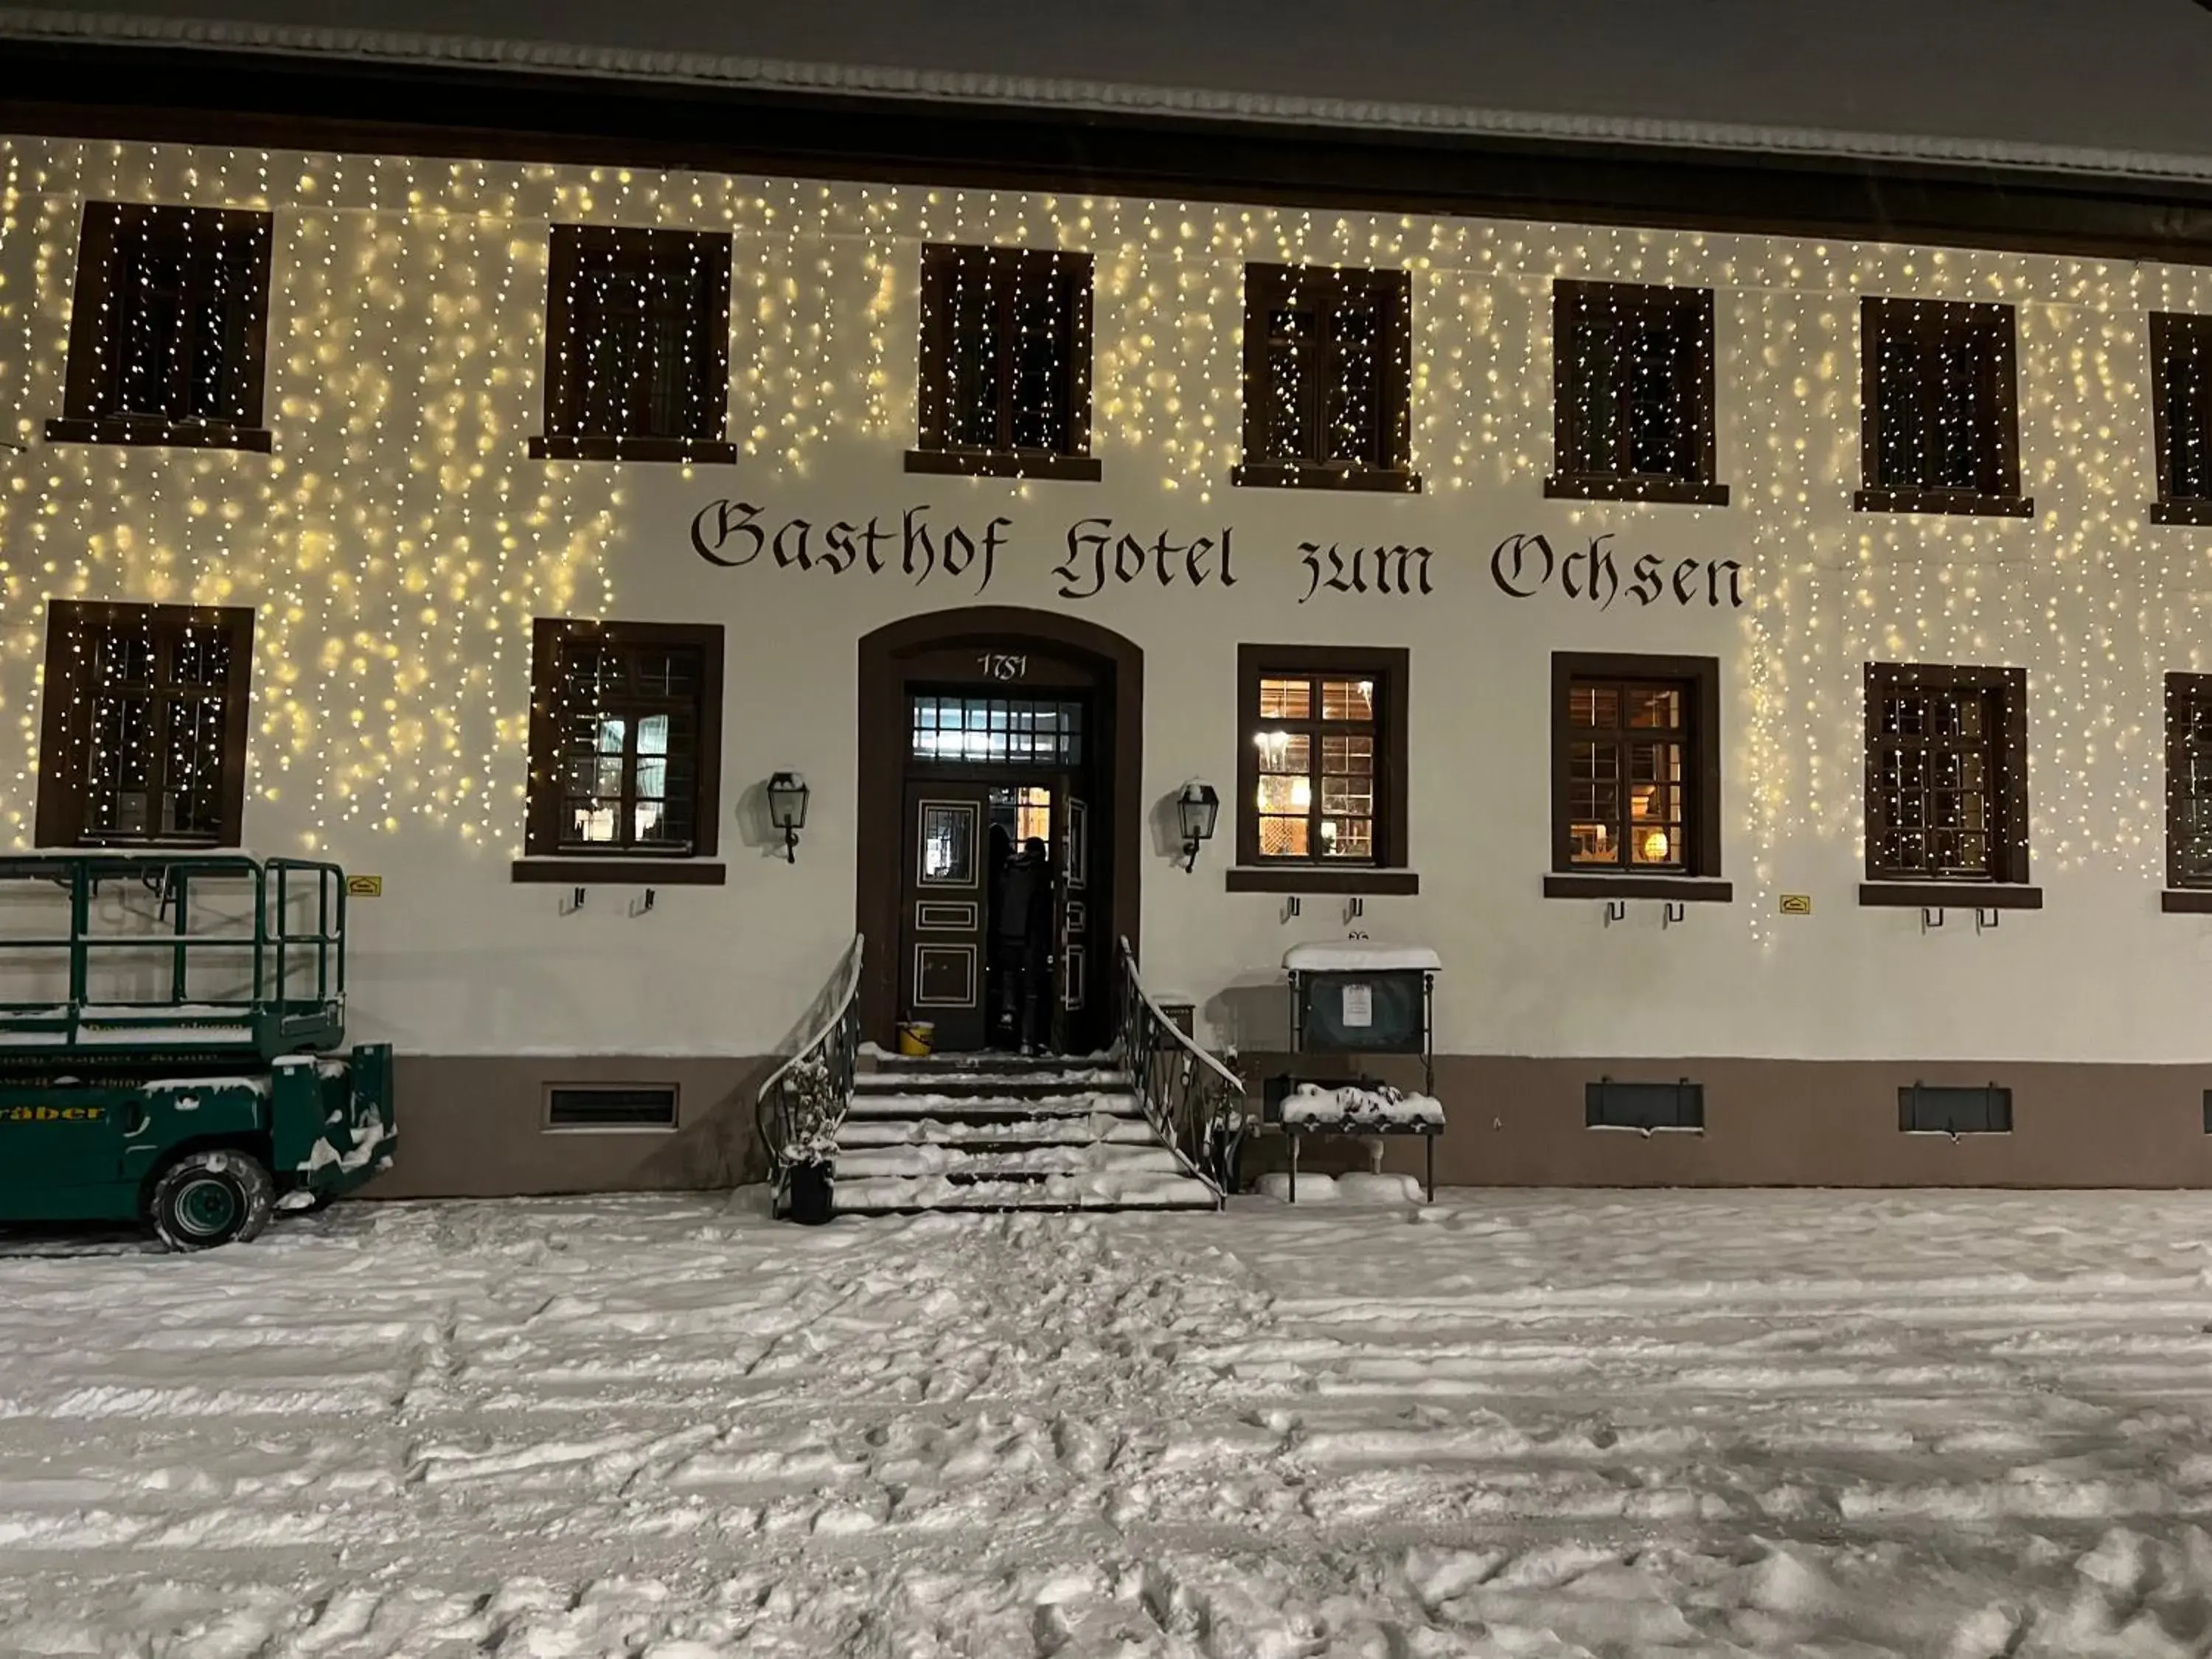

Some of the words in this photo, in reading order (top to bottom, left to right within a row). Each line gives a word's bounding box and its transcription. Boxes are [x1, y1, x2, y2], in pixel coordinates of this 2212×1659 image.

[691, 499, 1012, 592] Gasthof
[1051, 519, 1237, 599] Hotel
[1298, 543, 1433, 603] zum
[1491, 534, 1742, 609] Ochsen
[978, 654, 1026, 680] 1751
